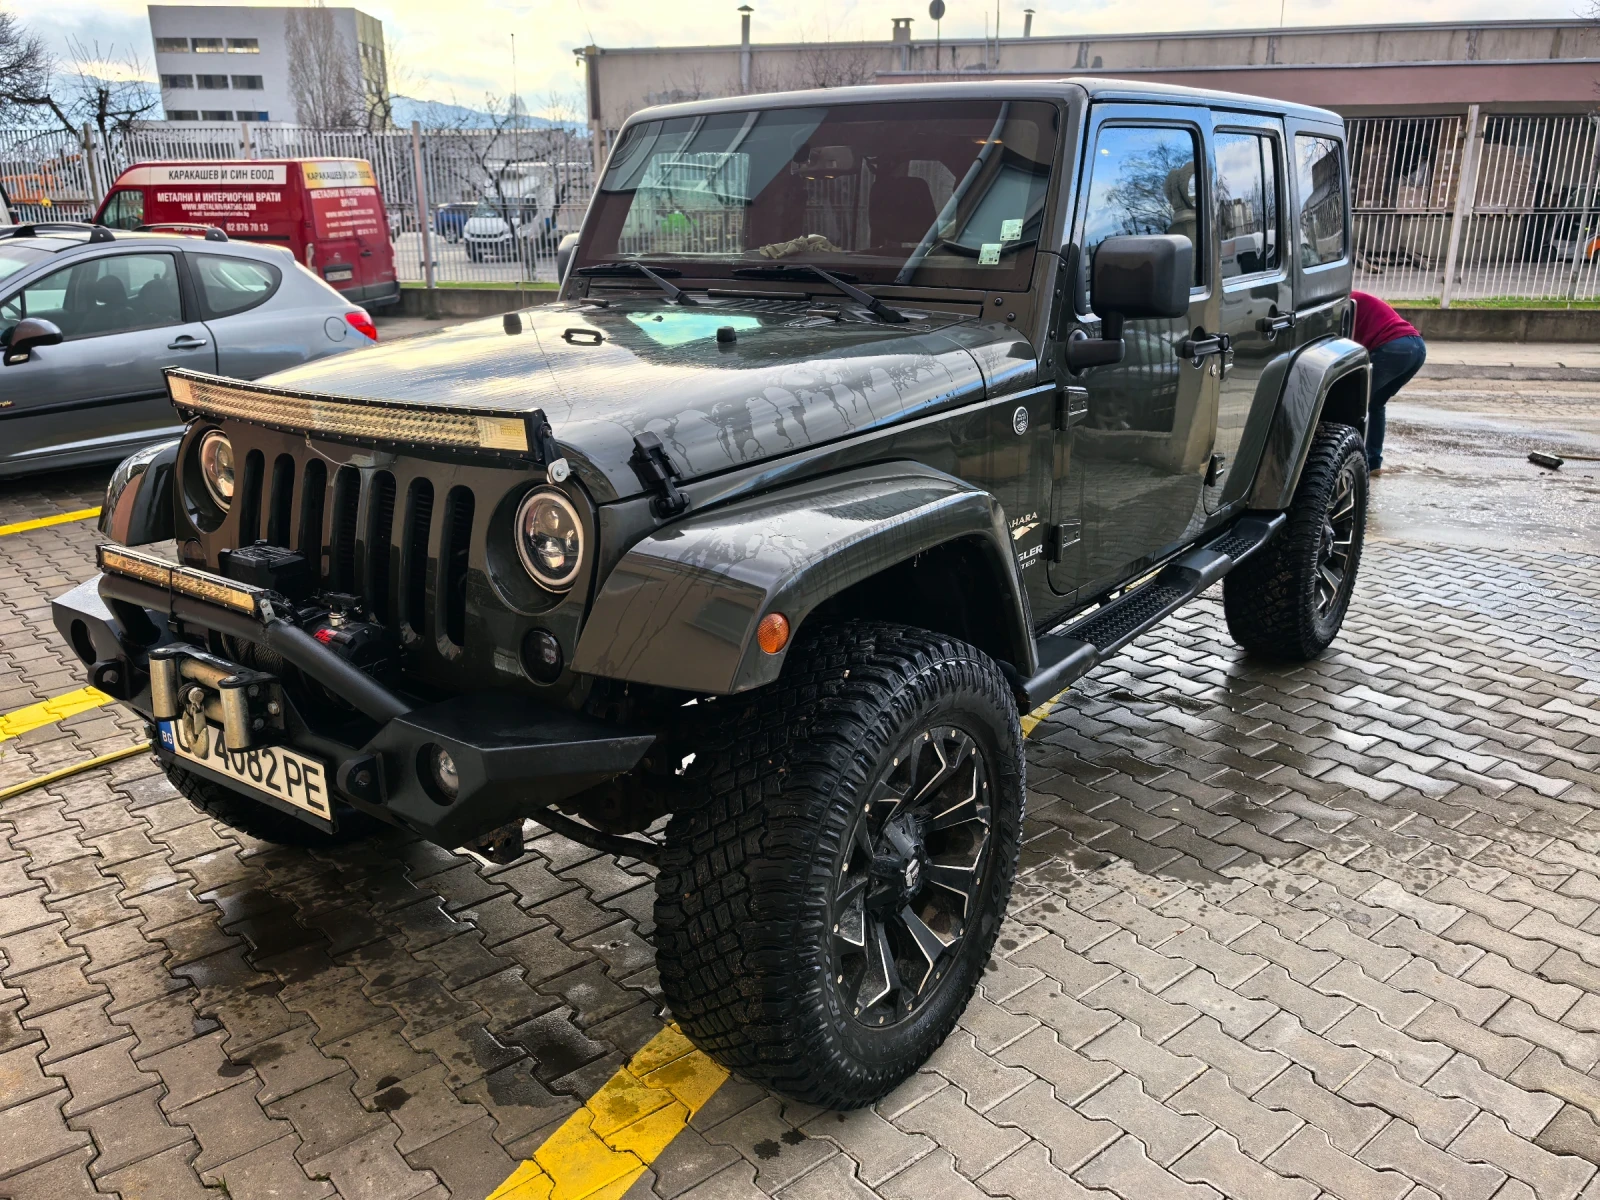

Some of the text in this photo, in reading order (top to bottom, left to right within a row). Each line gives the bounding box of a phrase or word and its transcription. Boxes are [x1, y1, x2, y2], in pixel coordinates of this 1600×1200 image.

[168, 169, 275, 181] КАРАКАШЕВ И СИН ЕООД
[157, 192, 282, 203] МЕТАЛНИ И ИНТЕРИОРНИ ВРАТИ
[226, 223, 236, 232] 02
[249, 223, 259, 232] 70
[259, 223, 269, 232] 13
[161, 730, 173, 745] BG
